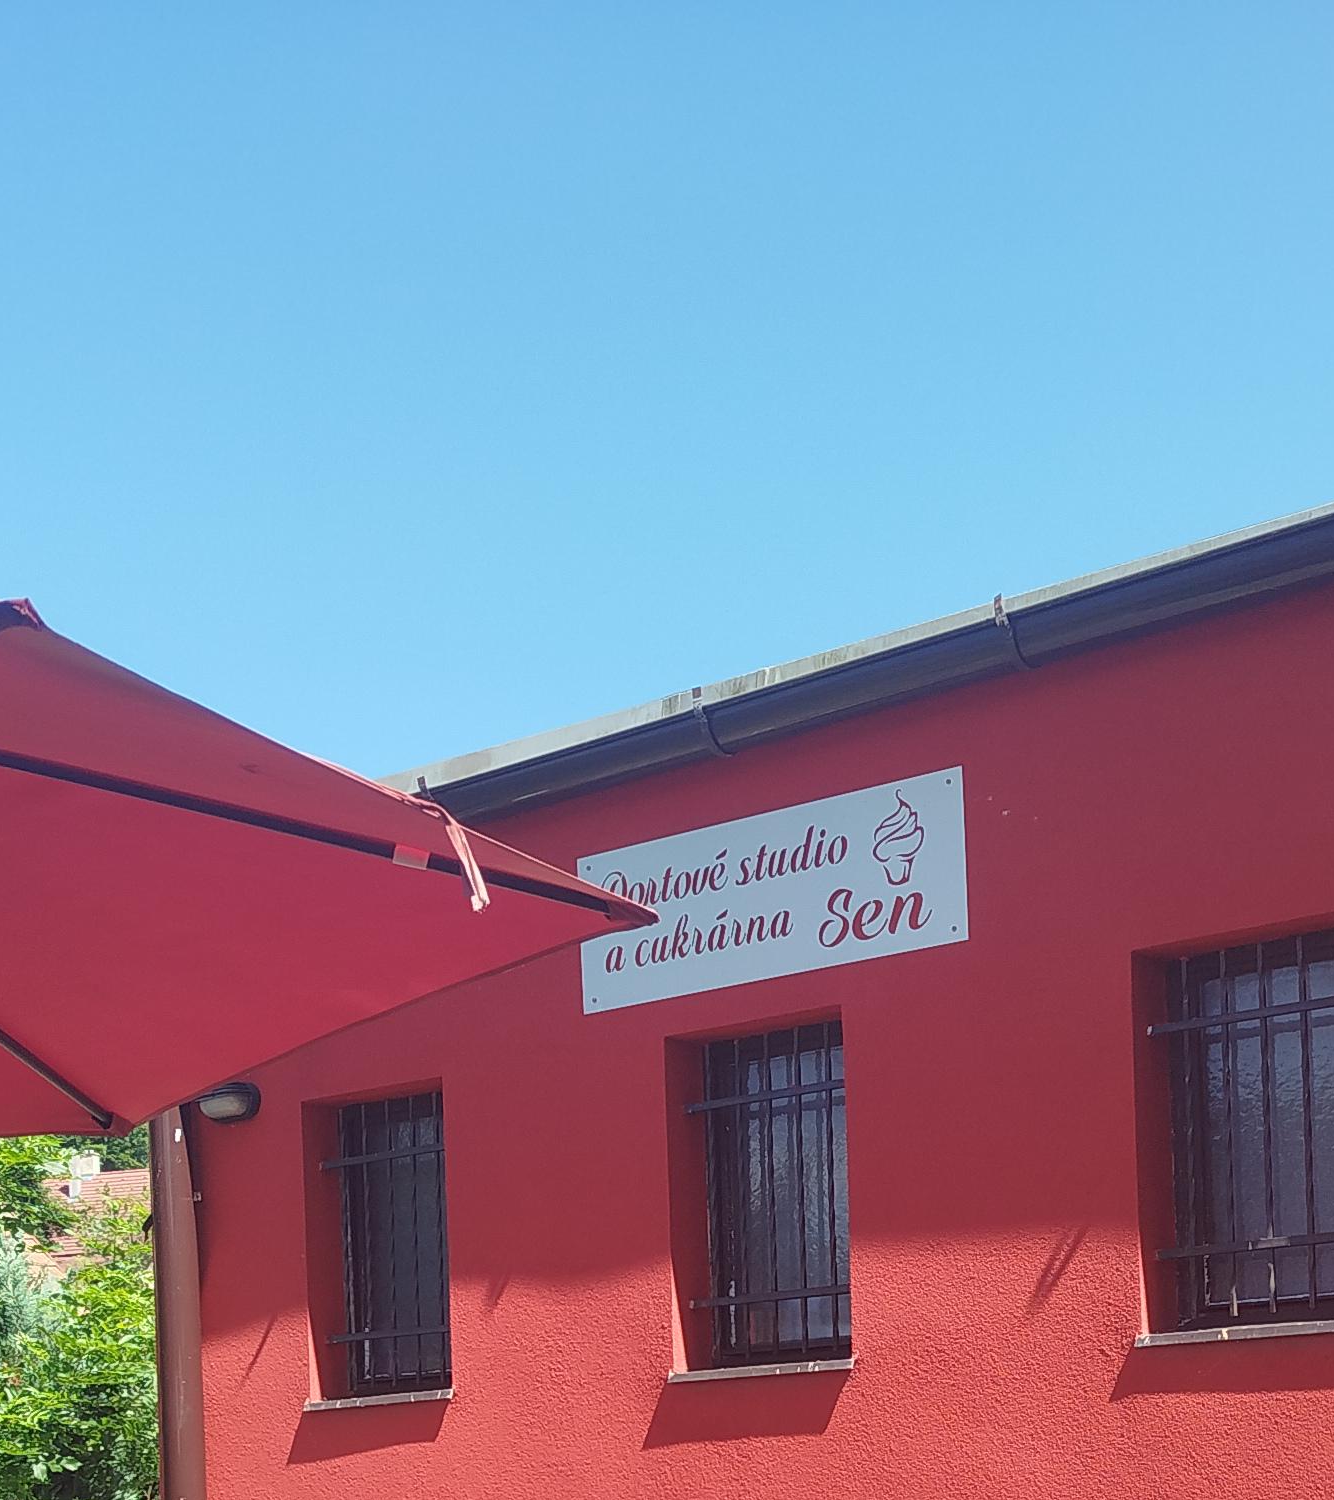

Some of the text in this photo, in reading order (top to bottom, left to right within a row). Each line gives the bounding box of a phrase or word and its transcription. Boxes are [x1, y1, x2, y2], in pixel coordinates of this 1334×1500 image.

[735, 825, 848, 886] studio
[605, 888, 933, 973] a cukrárna Sen
